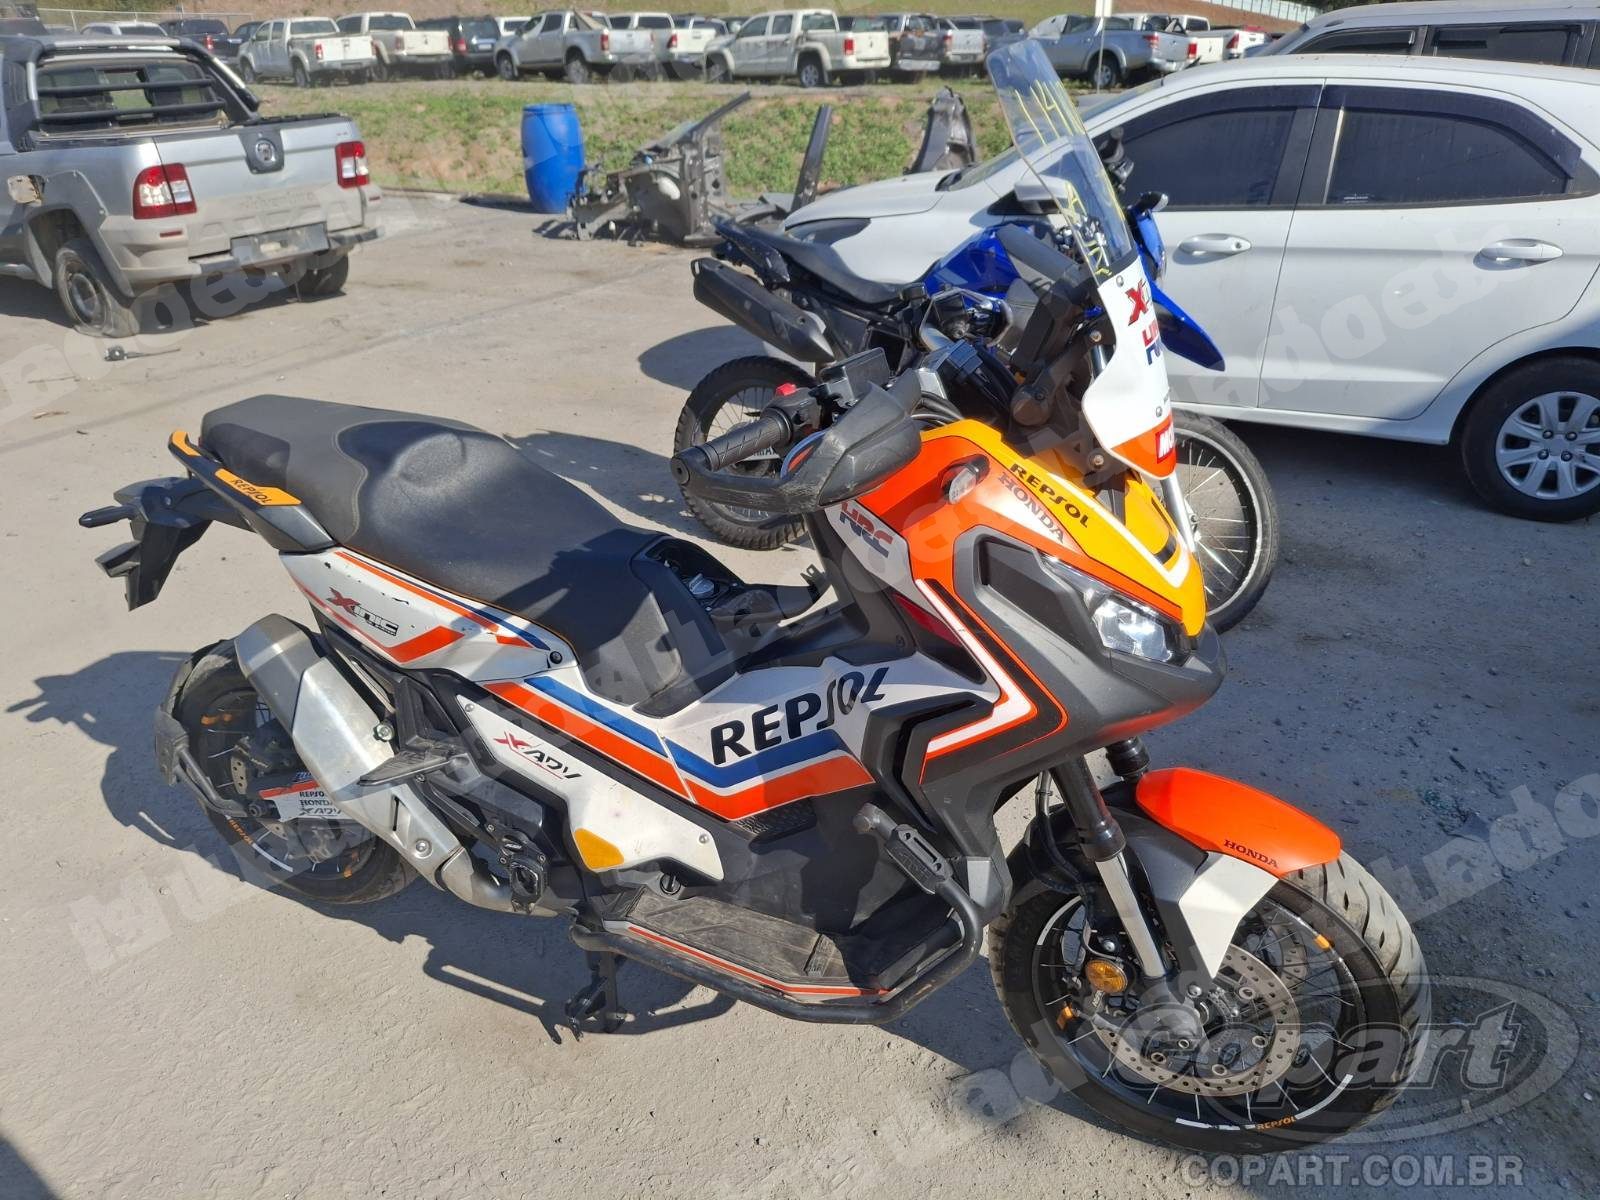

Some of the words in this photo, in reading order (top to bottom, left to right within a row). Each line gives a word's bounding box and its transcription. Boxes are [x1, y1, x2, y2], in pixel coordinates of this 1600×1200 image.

[1158, 427, 1175, 458] MO
[231, 478, 273, 504] REPSOL
[1009, 463, 1090, 528] REPSOL
[997, 471, 1065, 544] HONDA
[839, 501, 894, 559] HRC
[709, 666, 890, 765] REPSOL
[299, 790, 328, 798] REPSO
[1223, 839, 1279, 868] HONDA
[1256, 1115, 1297, 1131] REPSOL
